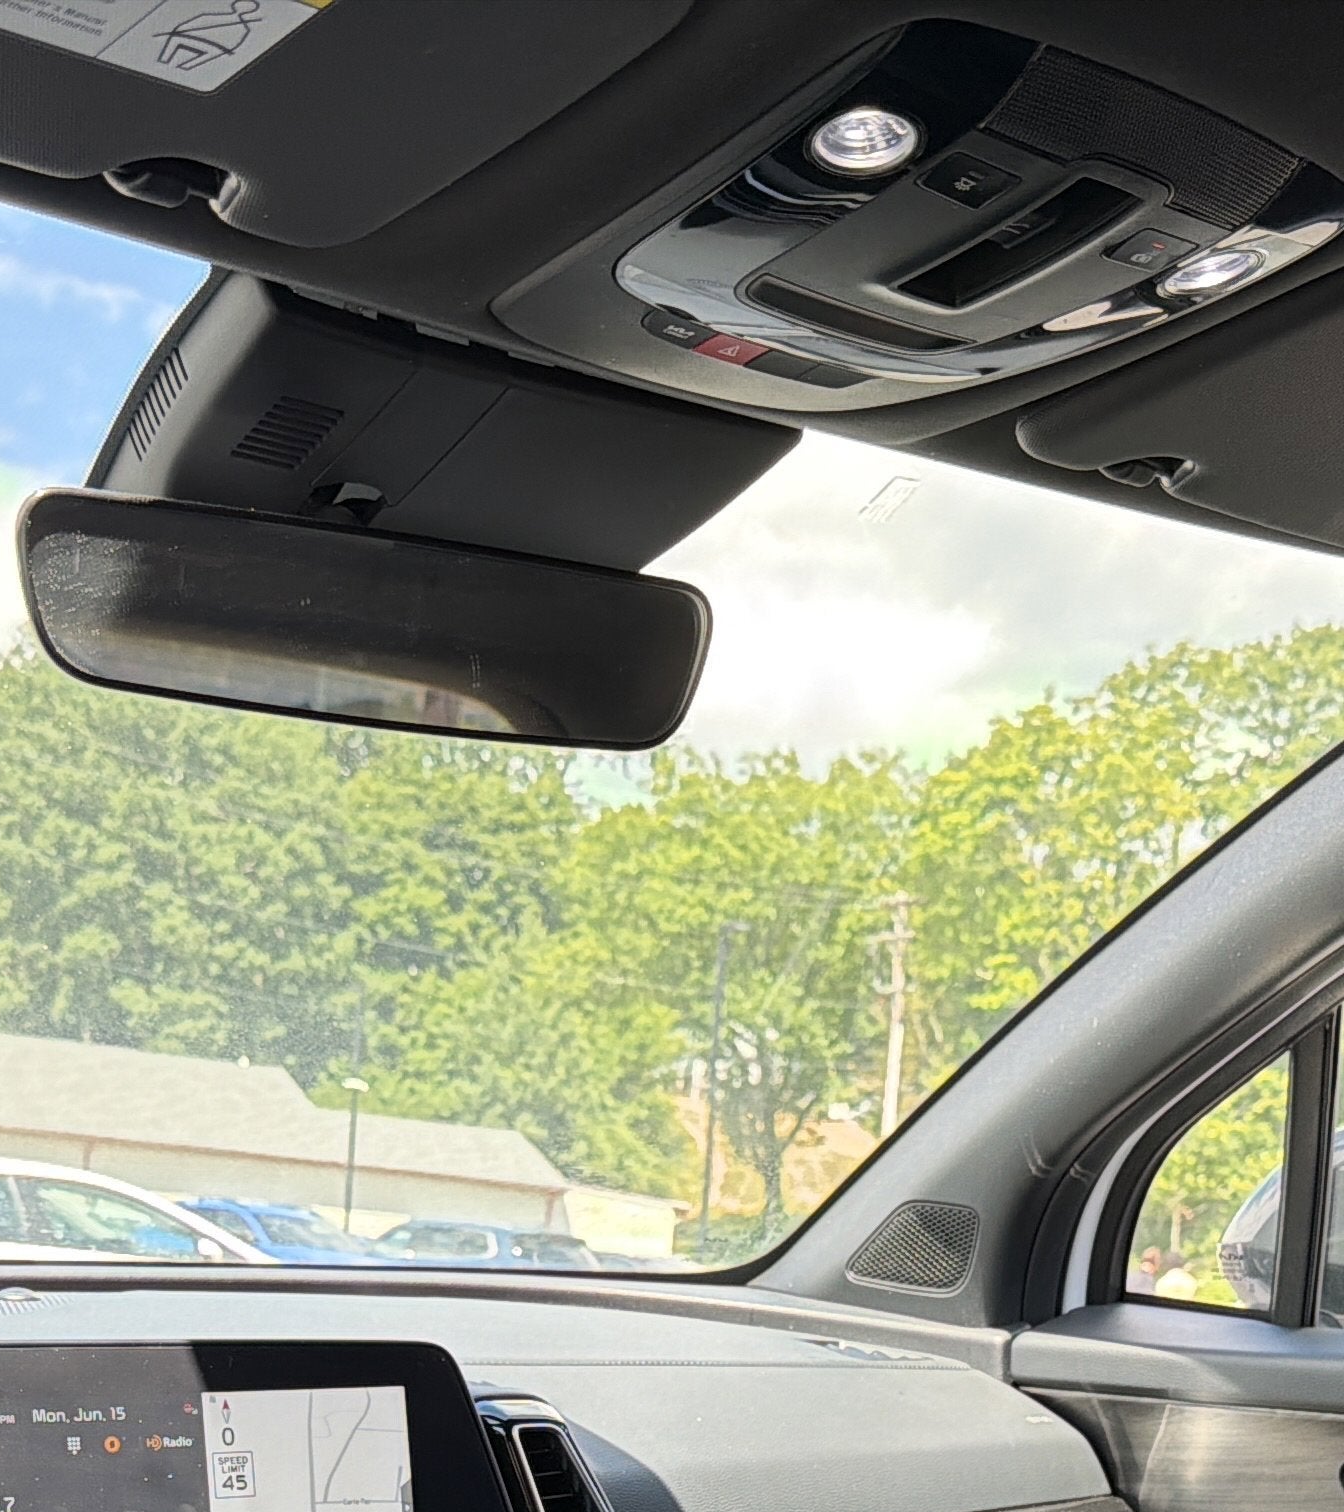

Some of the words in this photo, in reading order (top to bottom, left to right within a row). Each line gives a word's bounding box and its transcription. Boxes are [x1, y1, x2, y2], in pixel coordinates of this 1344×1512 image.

[0, 1414, 16, 1425] PM
[110, 1406, 126, 1421] 15
[163, 1435, 193, 1448] Radio
[221, 1426, 235, 1447] 0
[217, 1455, 249, 1466] SPEED
[221, 1464, 246, 1475] LIMIT
[222, 1474, 248, 1492] 45
